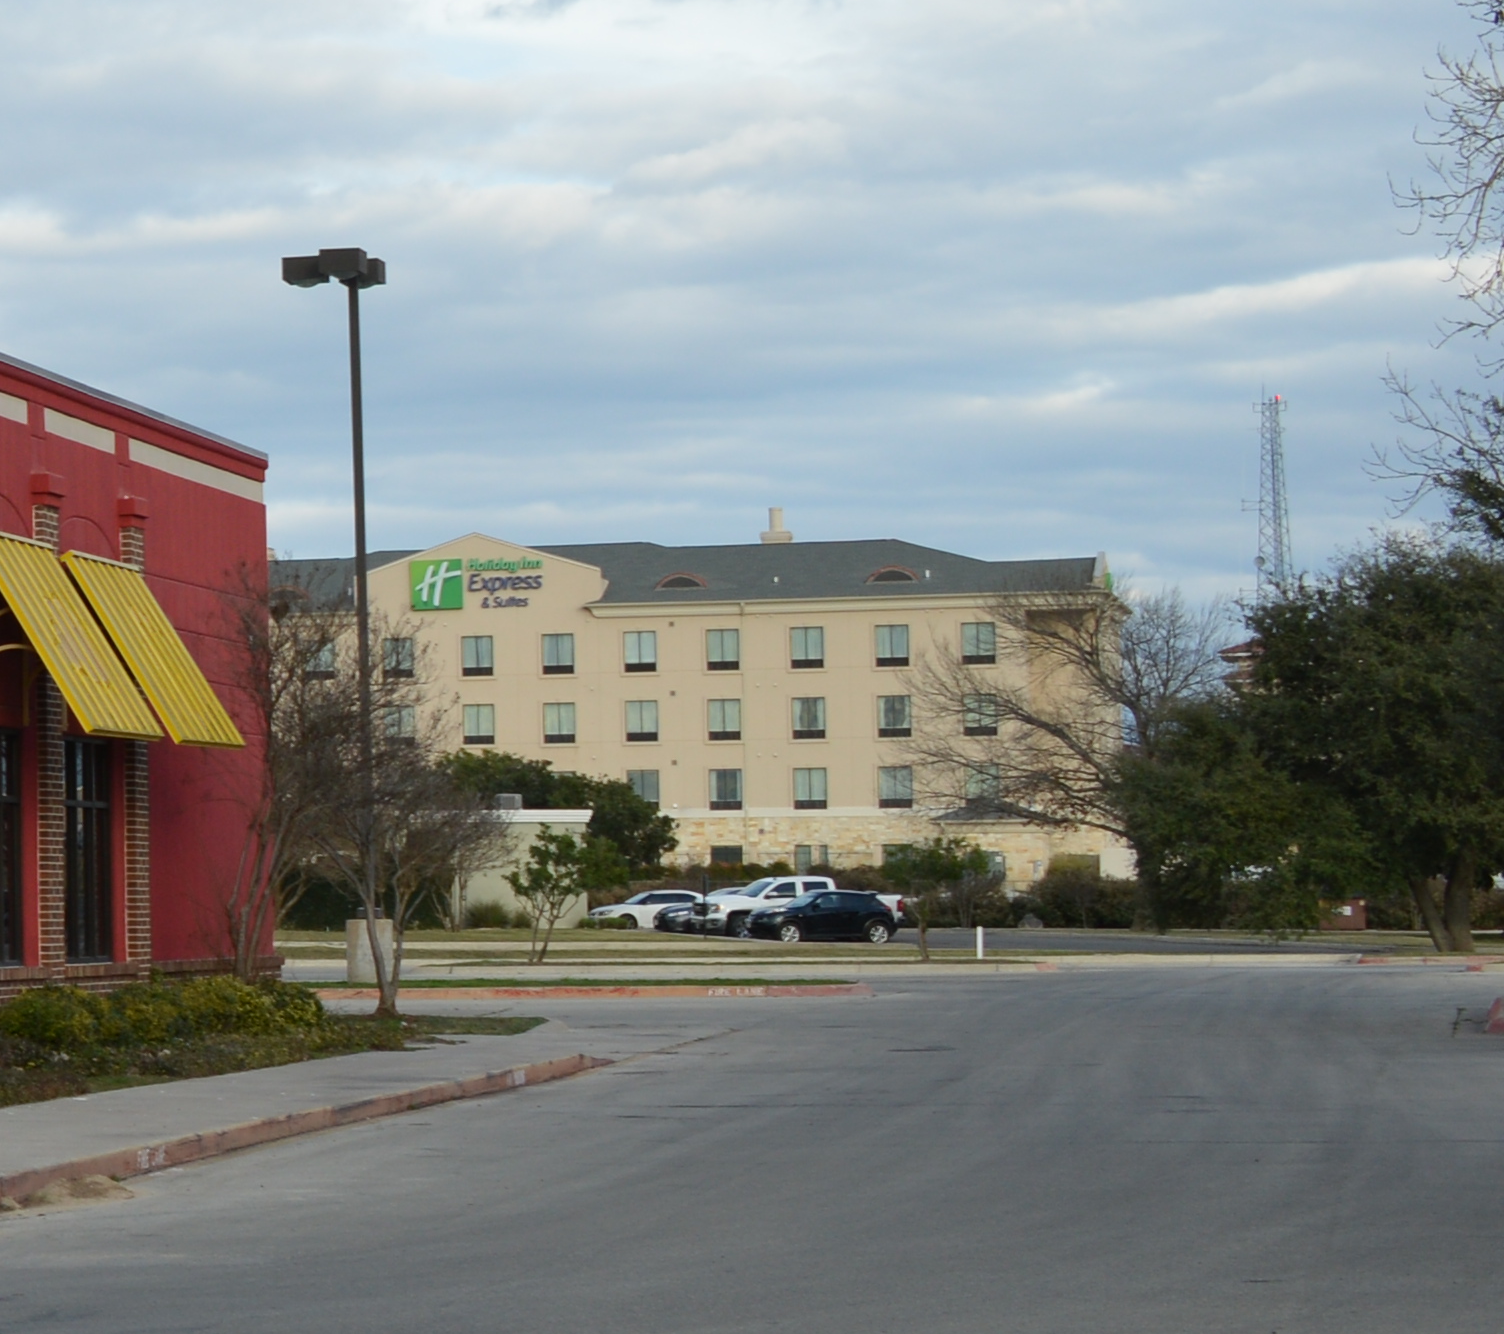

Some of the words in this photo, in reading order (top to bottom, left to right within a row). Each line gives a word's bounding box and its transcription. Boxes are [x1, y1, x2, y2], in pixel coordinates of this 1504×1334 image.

[467, 557, 518, 573] Holiday
[521, 556, 543, 569] Inn
[467, 573, 543, 595] Express
[481, 597, 490, 608] &
[493, 596, 529, 608] Suites
